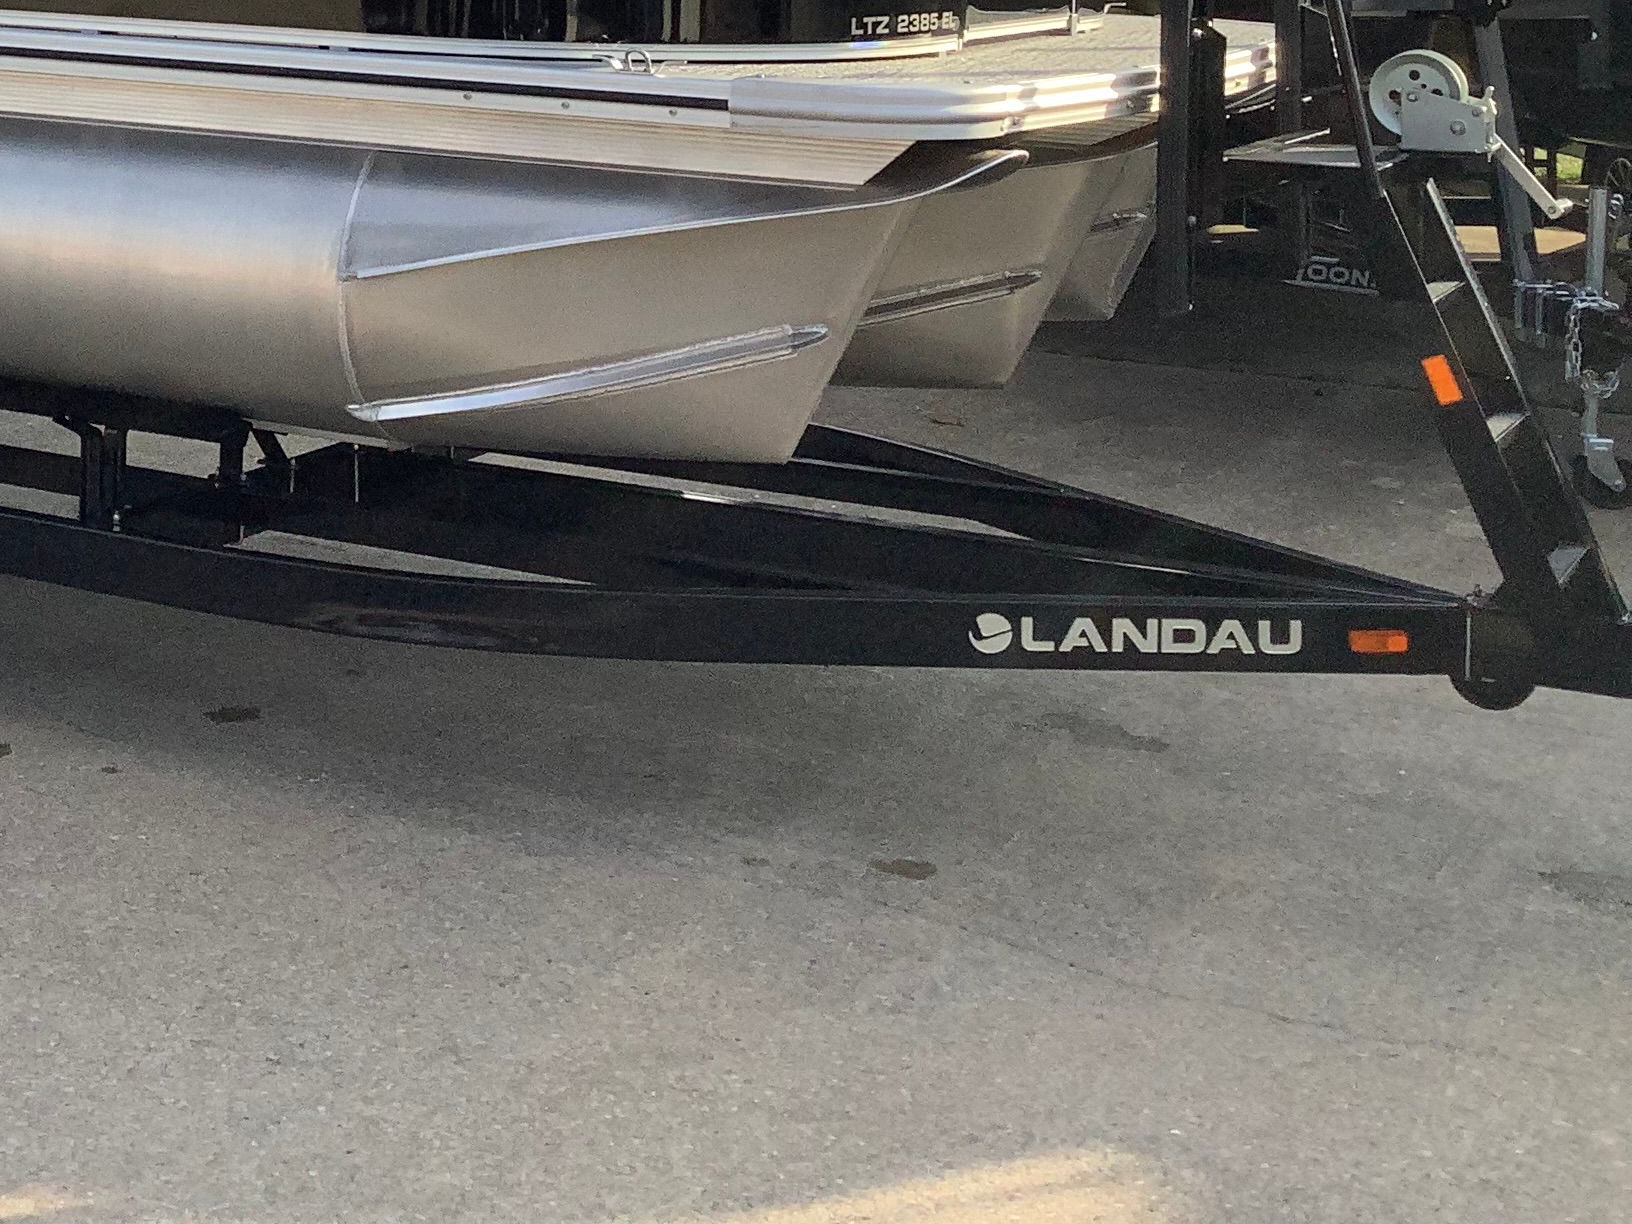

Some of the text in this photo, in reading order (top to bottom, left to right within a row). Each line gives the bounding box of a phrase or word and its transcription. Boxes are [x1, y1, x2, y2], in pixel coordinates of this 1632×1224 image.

[850, 15, 890, 36] LTZ
[896, 12, 939, 34] 2385
[1020, 616, 1303, 655] LANDAU
